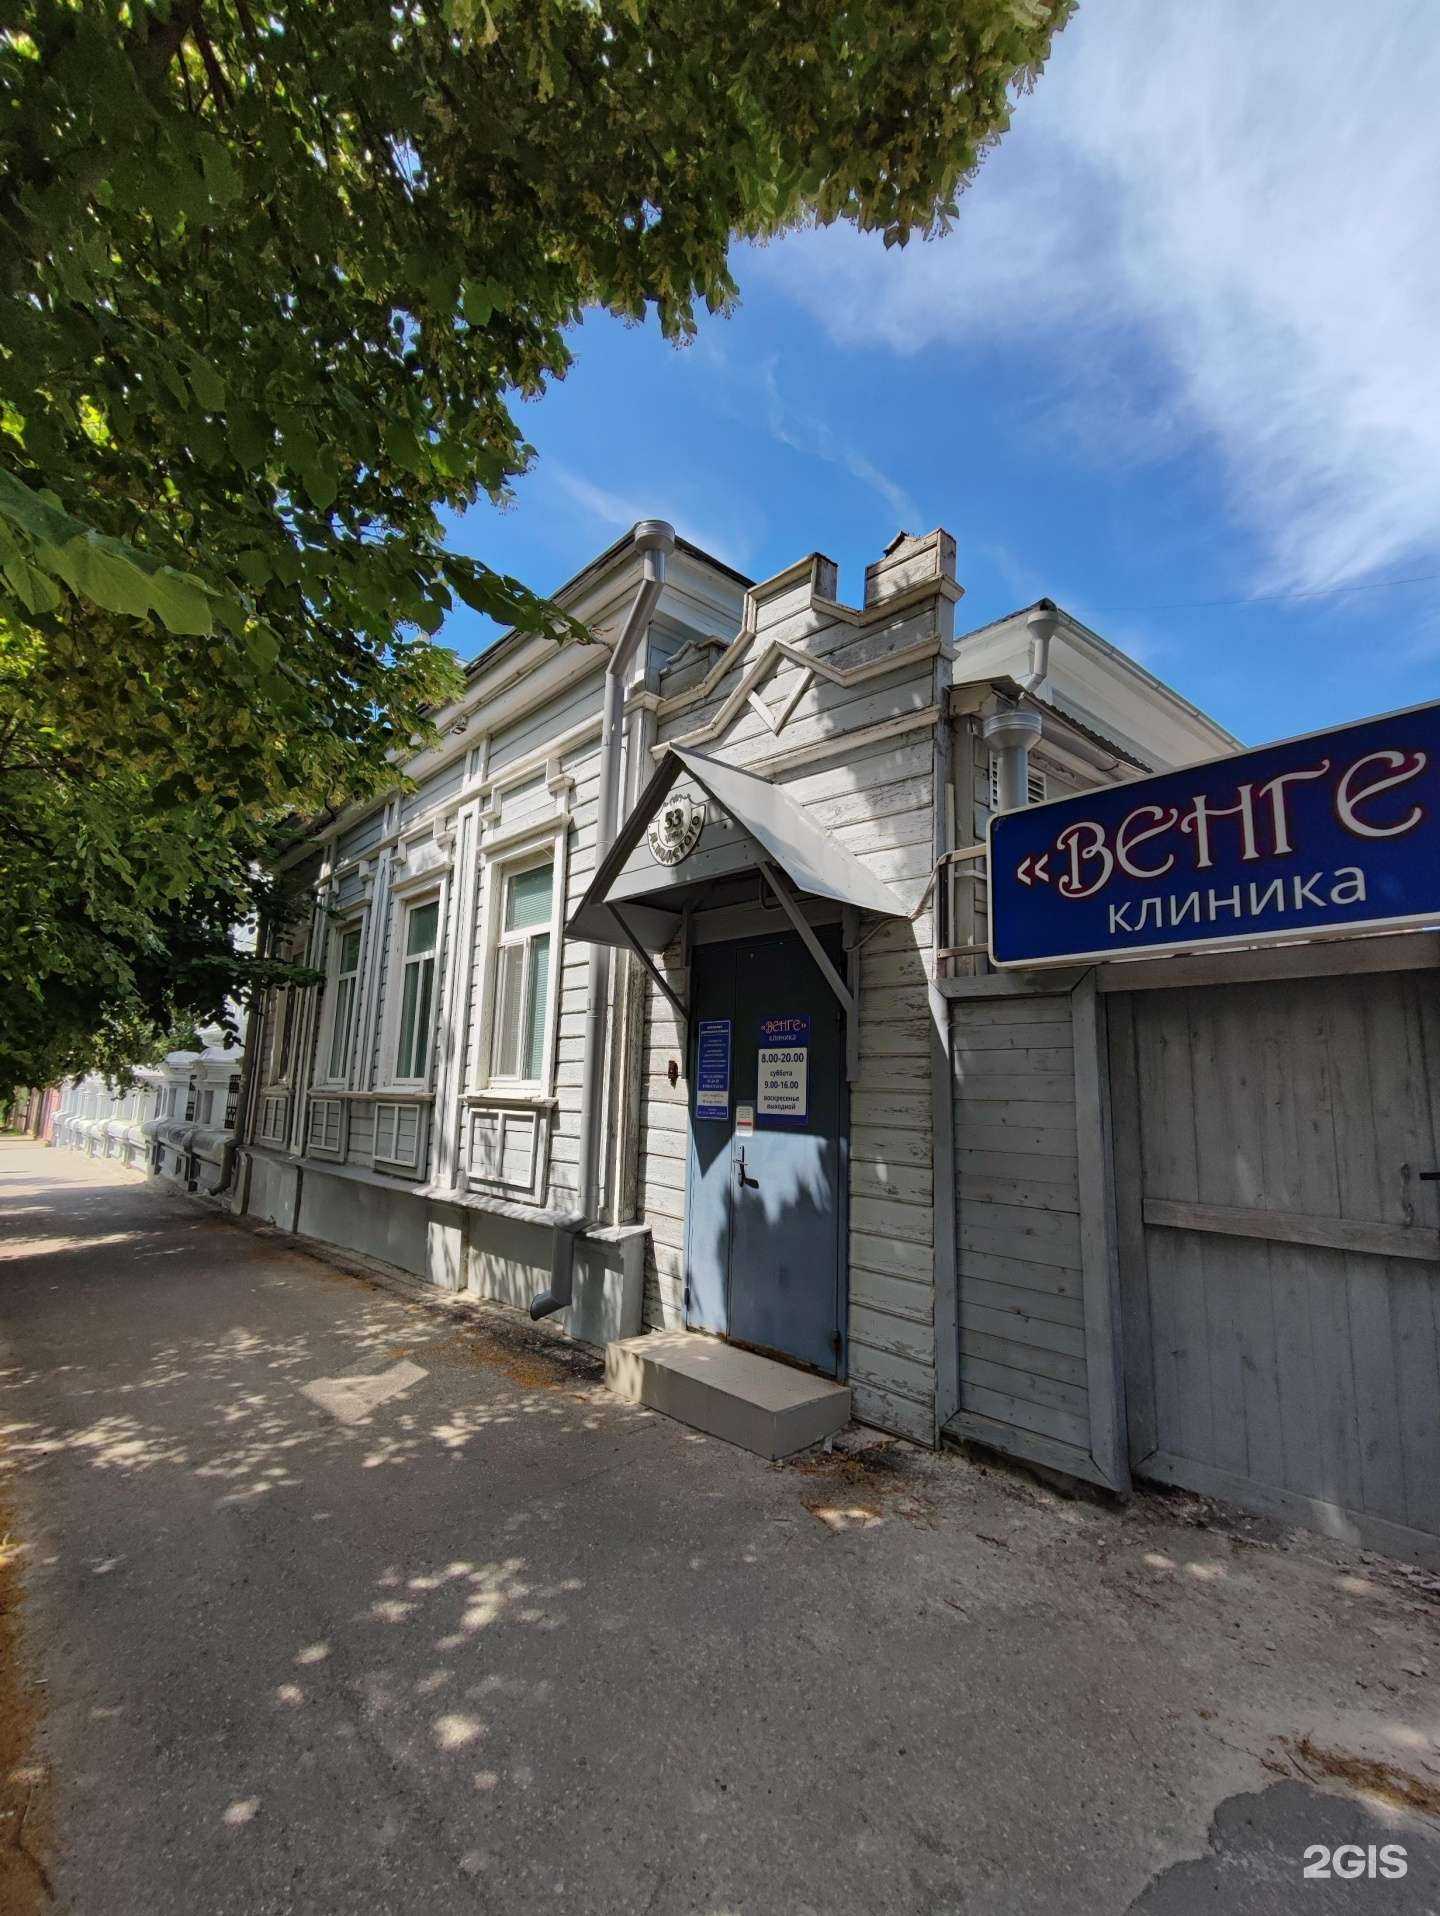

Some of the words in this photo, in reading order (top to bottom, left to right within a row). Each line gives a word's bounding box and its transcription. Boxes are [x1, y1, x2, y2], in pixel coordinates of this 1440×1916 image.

[665, 808, 684, 829] 53
[1108, 866, 1367, 934] клиника
[761, 1053, 805, 1063] 8.00-20.00
[764, 1081, 799, 1089] 9.00-16.00
